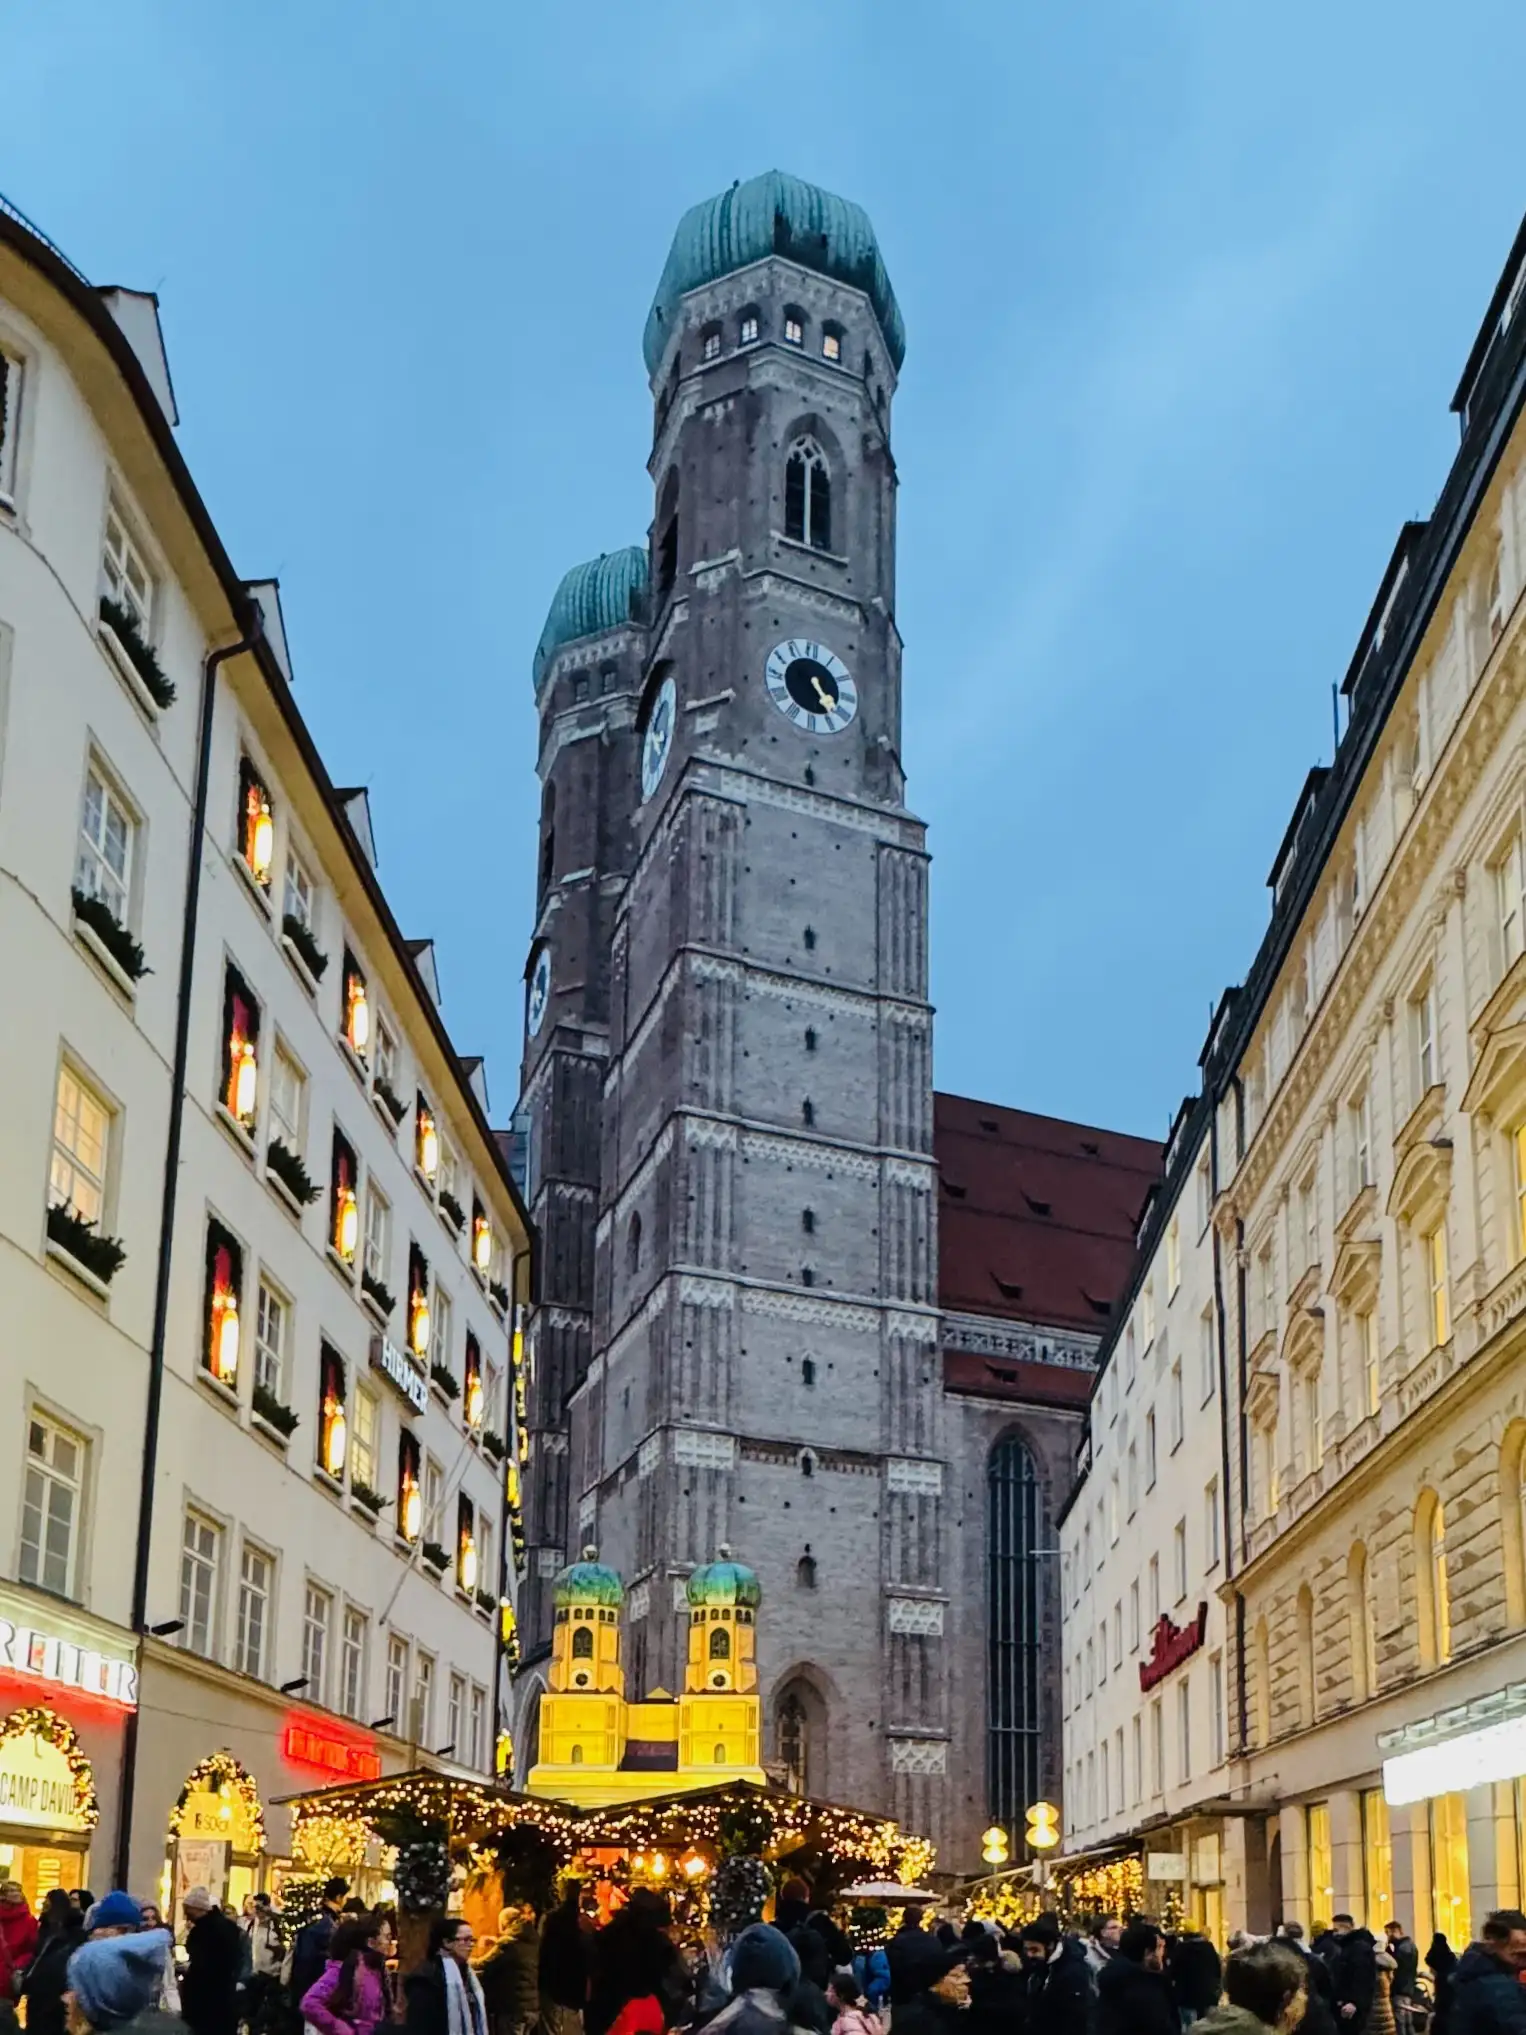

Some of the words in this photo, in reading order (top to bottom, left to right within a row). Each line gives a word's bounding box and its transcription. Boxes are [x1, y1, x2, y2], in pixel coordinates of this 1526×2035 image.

[382, 1334, 428, 1414] HIRMER
[0, 1772, 38, 1810] CAMP
[40, 1779, 76, 1816] DAVID
